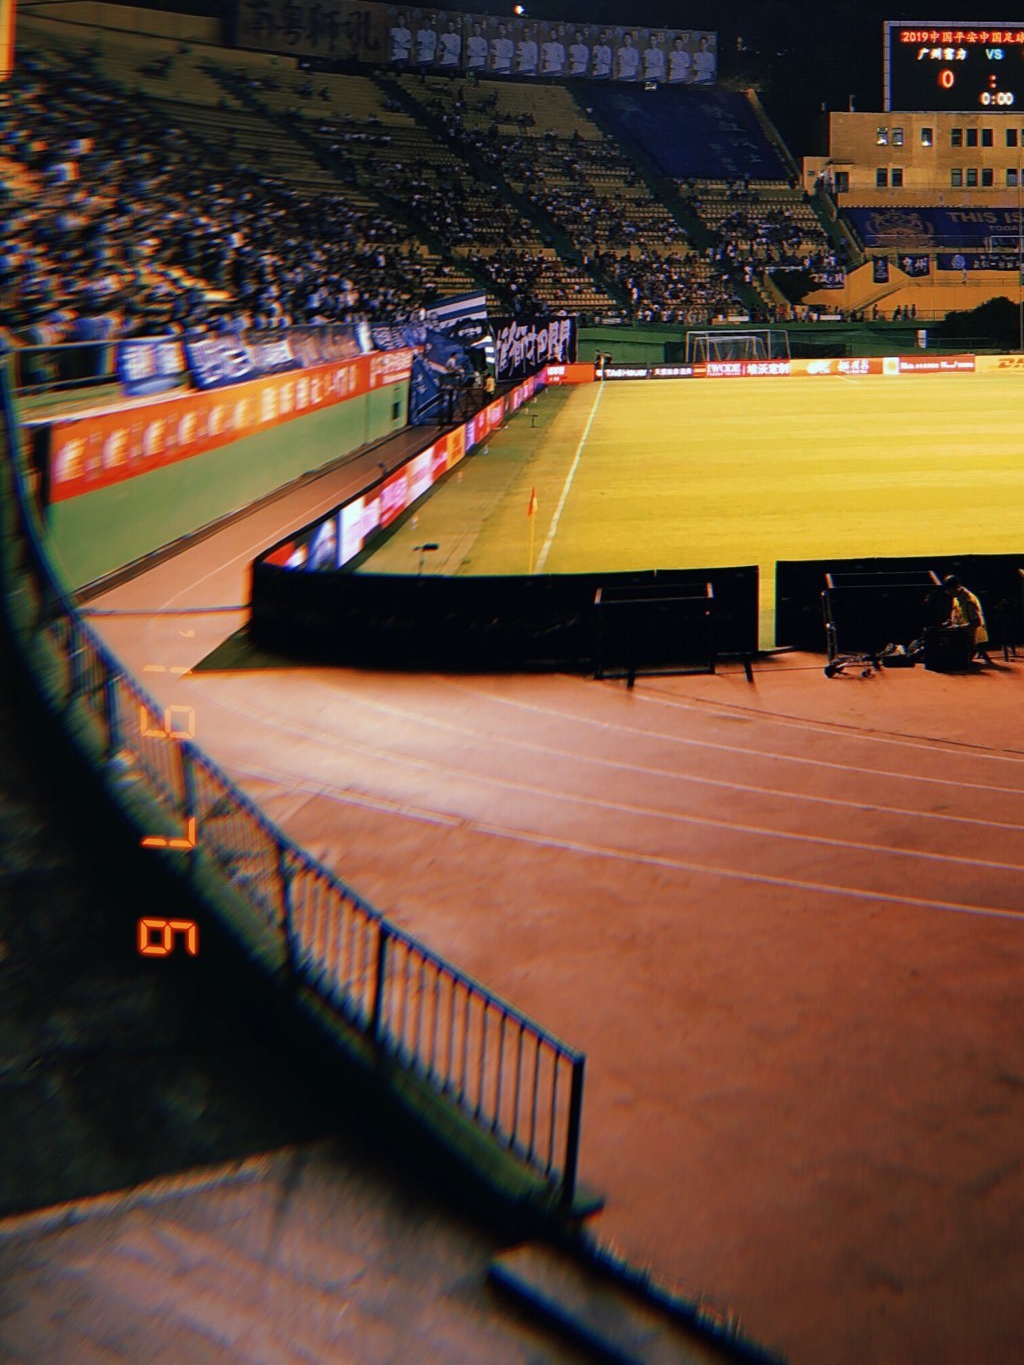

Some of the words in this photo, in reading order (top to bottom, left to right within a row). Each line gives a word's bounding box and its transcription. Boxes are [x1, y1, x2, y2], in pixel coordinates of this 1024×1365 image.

[917, 48, 968, 61] 广州富力
[985, 48, 1004, 60] VS
[939, 71, 955, 89] 0
[980, 92, 1014, 106] 0:00
[946, 211, 998, 225] THIS
[988, 224, 1024, 232] TODAY
